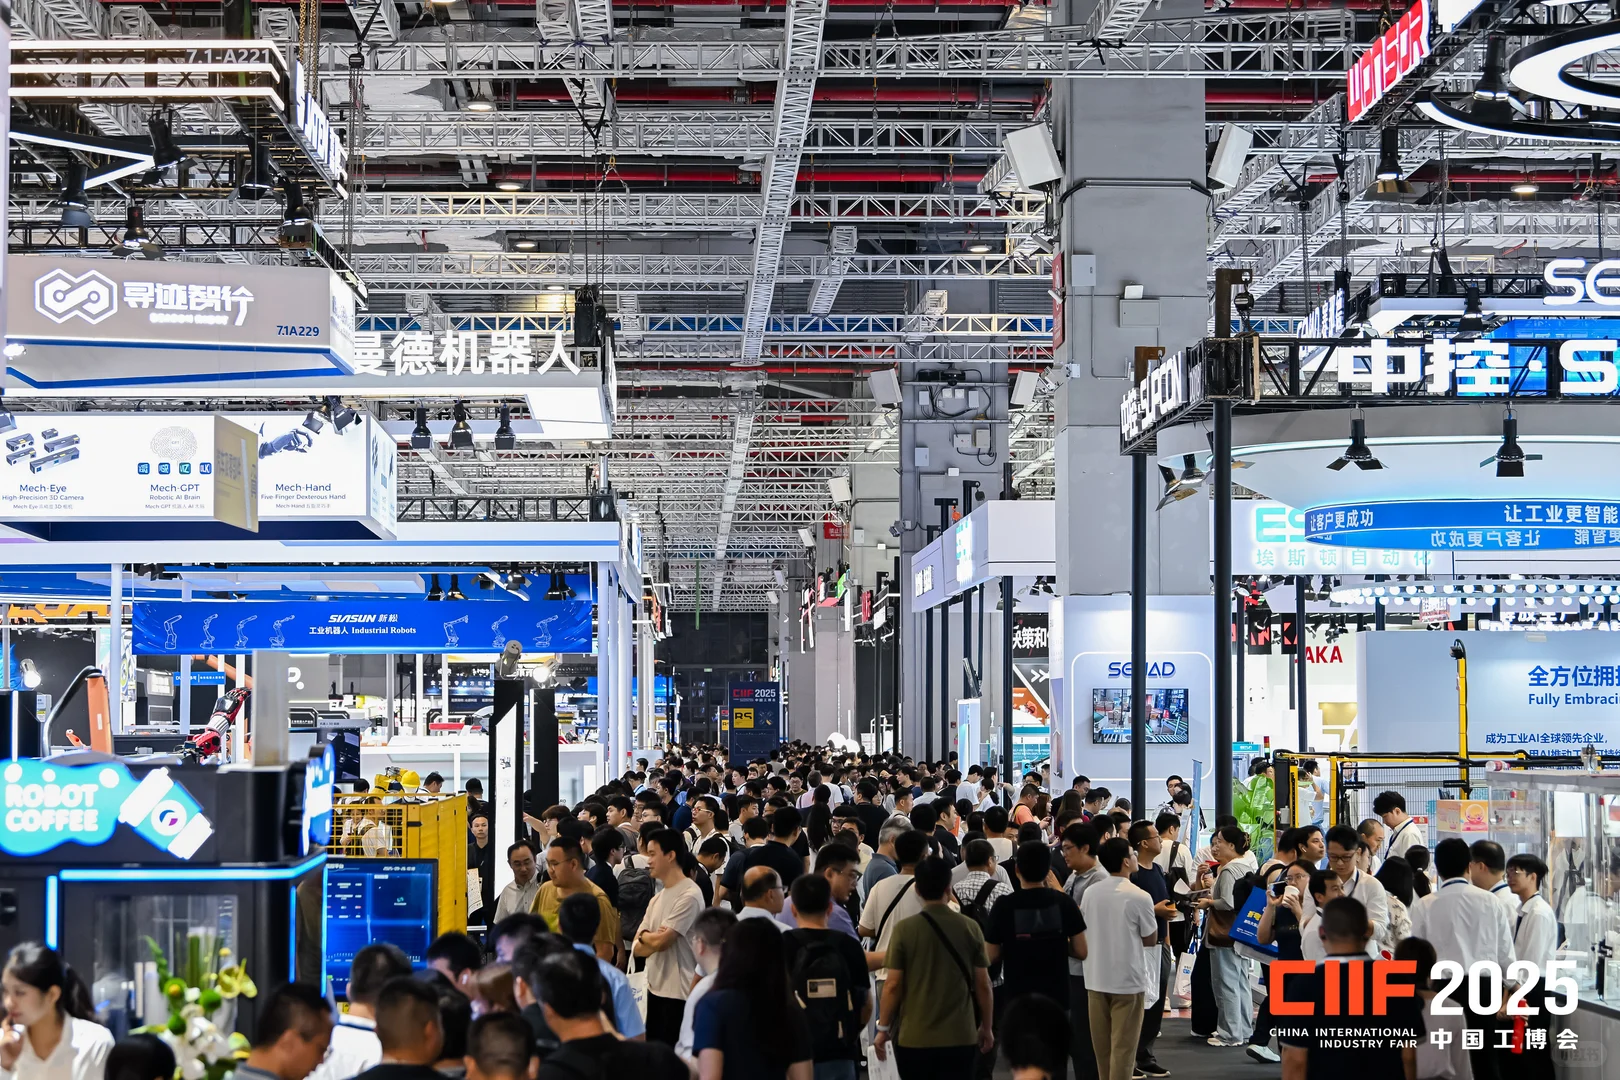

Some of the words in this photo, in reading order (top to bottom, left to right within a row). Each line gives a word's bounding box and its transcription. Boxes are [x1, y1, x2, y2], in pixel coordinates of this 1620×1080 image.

[185, 48, 271, 65] 7.1-A221
[20, 484, 67, 494] Mech-Eye
[150, 484, 200, 492] Mech-GPT
[276, 483, 332, 492] Mech-Hand
[1310, 508, 1374, 532] 让客户更成功
[1504, 504, 1618, 524] 让工业更智能
[1256, 548, 1432, 567] 埃斯顿自动化
[328, 614, 377, 623] SIASUN
[378, 614, 398, 623] 新松
[309, 626, 349, 635] 工业机器人
[351, 626, 389, 635] Industrial
[390, 626, 417, 635] Robots
[1294, 646, 1344, 664] AKA
[1108, 662, 1176, 677] SEAD
[733, 689, 754, 698] CIIF
[755, 689, 776, 698] 2025
[1528, 693, 1560, 708] Fully
[1564, 693, 1620, 705] Embraci
[1486, 733, 1608, 744] 成为工业AI全球领先企业，
[5, 782, 99, 808] ROBOT
[5, 809, 99, 832] COFFEE
